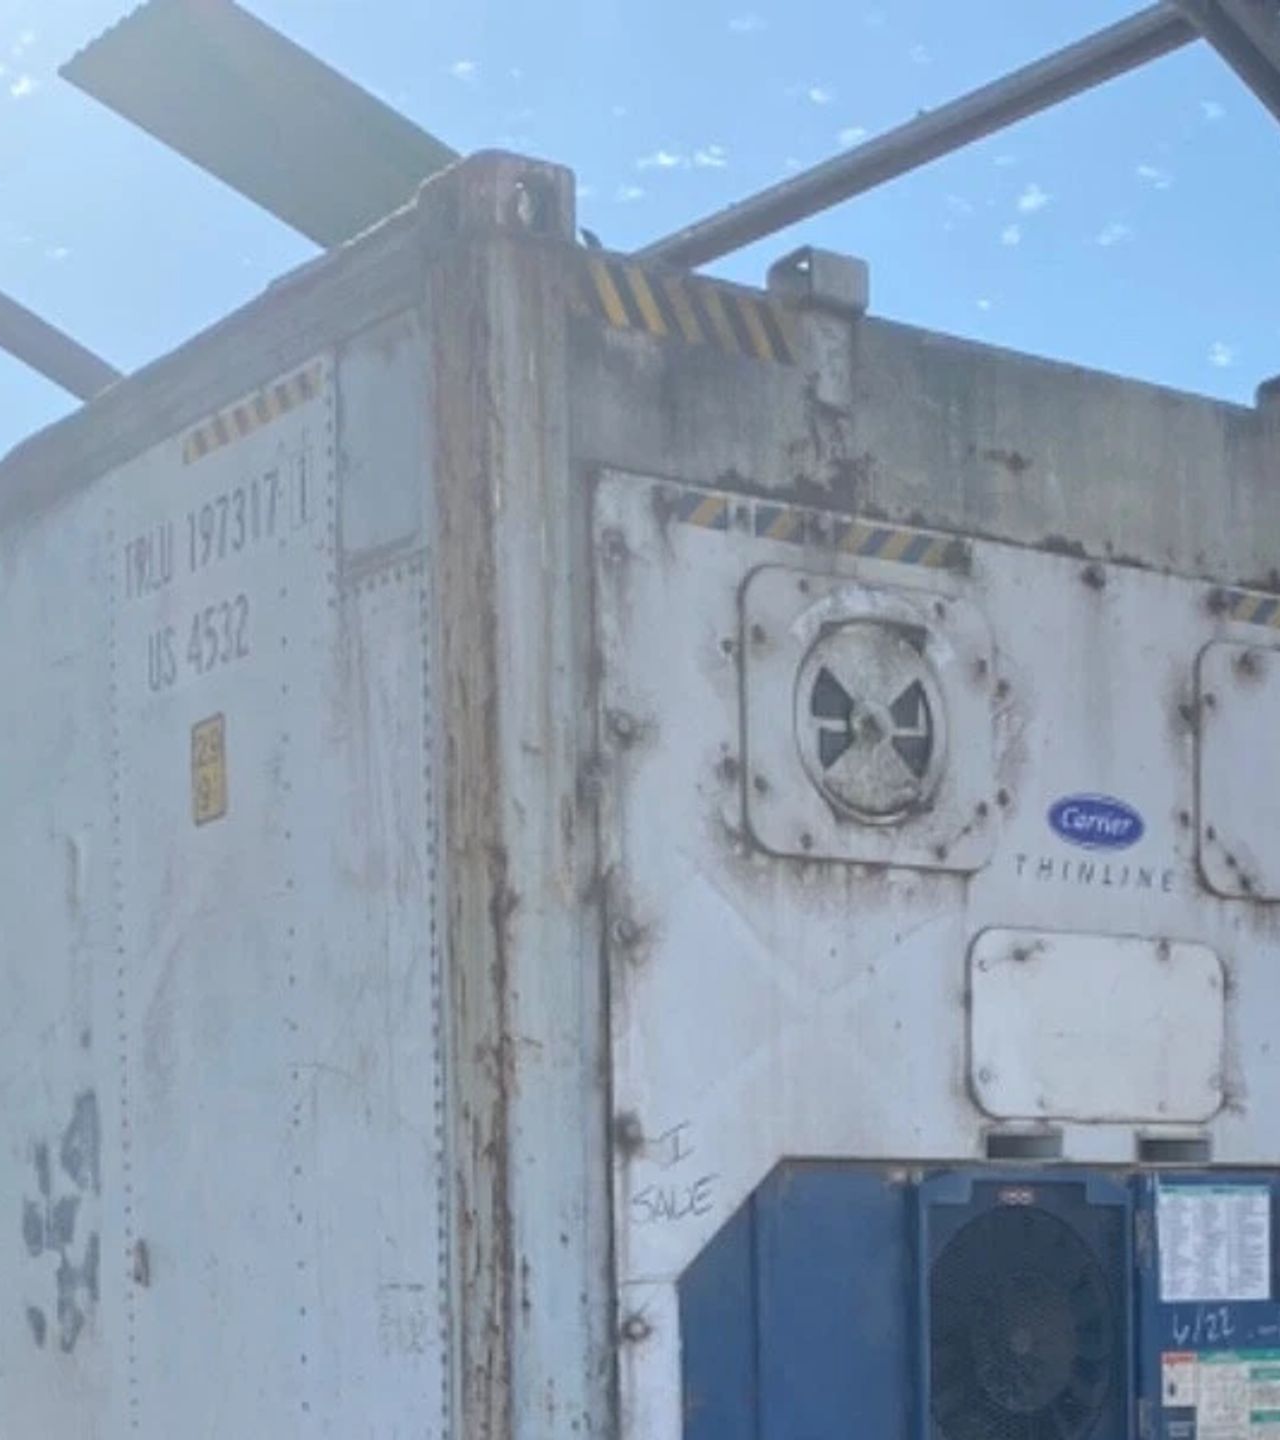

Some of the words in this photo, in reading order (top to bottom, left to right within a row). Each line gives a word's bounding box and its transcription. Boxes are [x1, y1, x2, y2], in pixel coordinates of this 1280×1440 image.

[187, 467, 280, 573] 197317
[147, 625, 177, 692] US
[186, 592, 251, 675] 4532
[1060, 805, 1135, 837] Carrier
[1015, 852, 1176, 893] THINLINE
